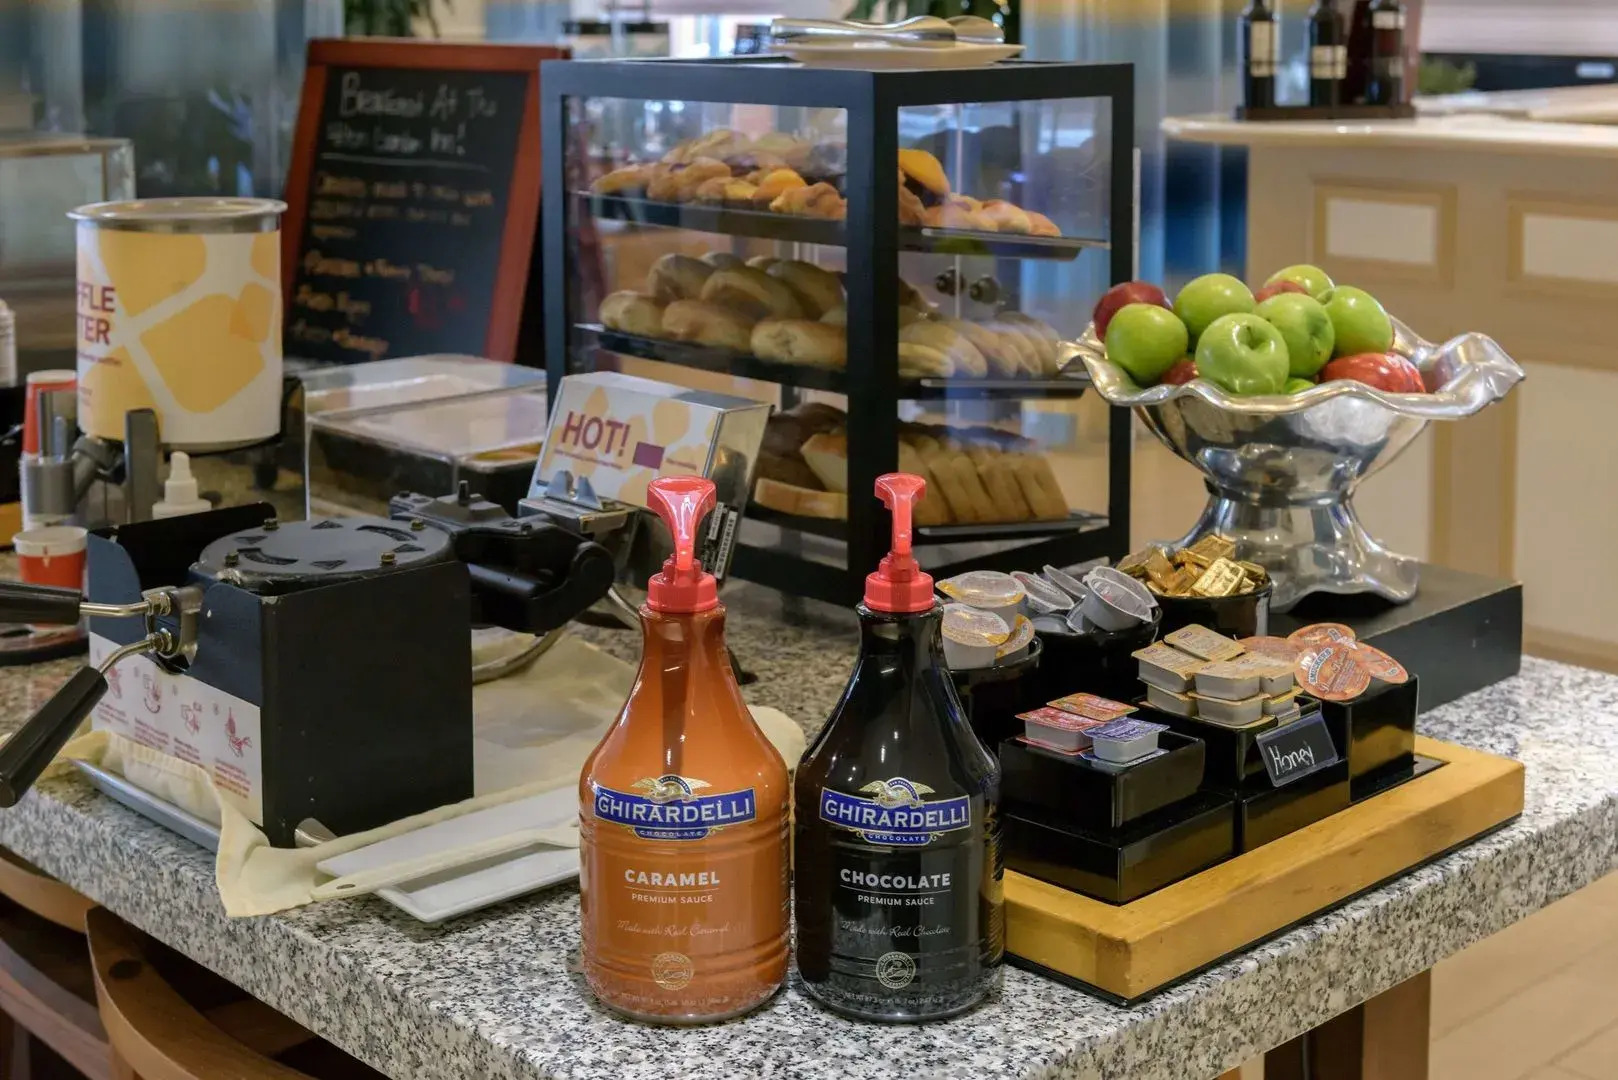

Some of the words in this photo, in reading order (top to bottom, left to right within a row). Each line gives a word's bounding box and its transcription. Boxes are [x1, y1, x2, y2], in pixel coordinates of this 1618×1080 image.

[562, 411, 631, 457] HOT!
[1268, 745, 1316, 775] Honey
[598, 796, 751, 823] GHIRARDELLI
[825, 799, 967, 828] GHIRARDELLI
[640, 830, 703, 838] CHOCOLATE
[868, 834, 926, 842] CHOCOLATE
[625, 869, 720, 887] CARAMEL
[840, 869, 951, 889] CHOCOLATE
[632, 893, 677, 904] PREMIUM
[680, 894, 713, 904] SAUCE
[858, 895, 902, 906] PREMIUM
[905, 897, 935, 906] SAUCE
[890, 925, 912, 938] Real
